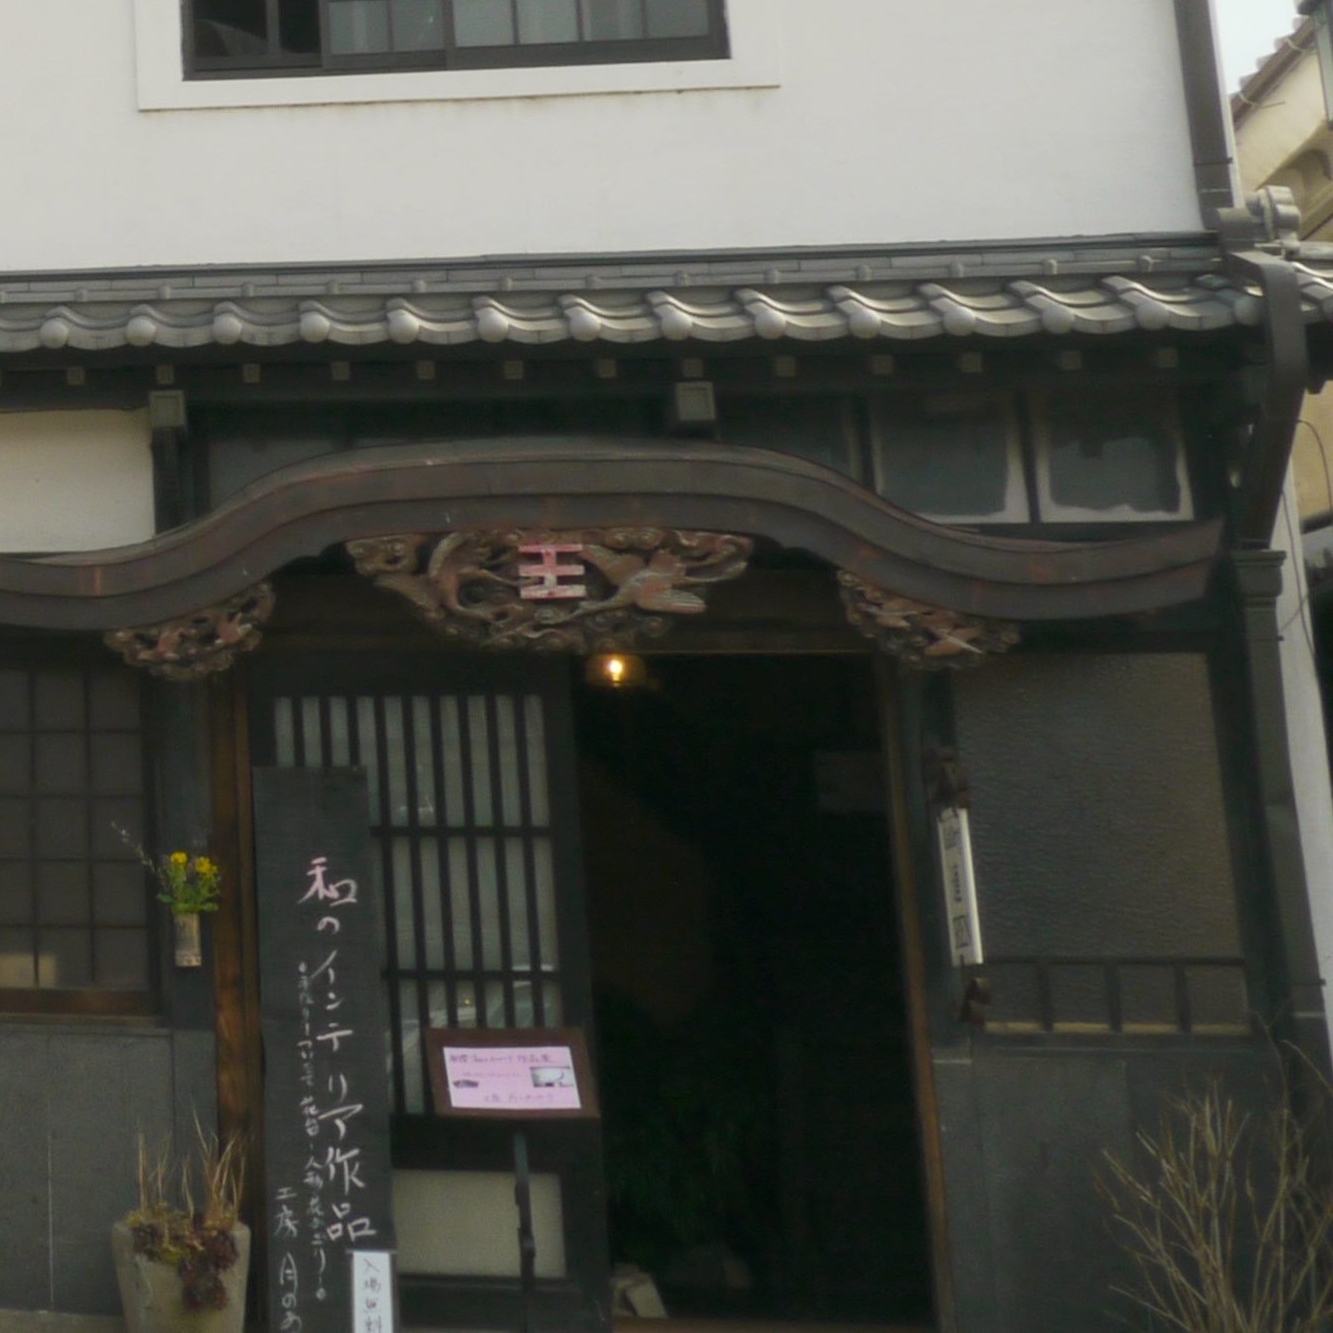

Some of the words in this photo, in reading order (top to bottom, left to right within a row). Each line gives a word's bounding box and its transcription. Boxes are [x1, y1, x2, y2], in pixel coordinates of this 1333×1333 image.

[297, 856, 377, 1243] 和のインテリア作品
